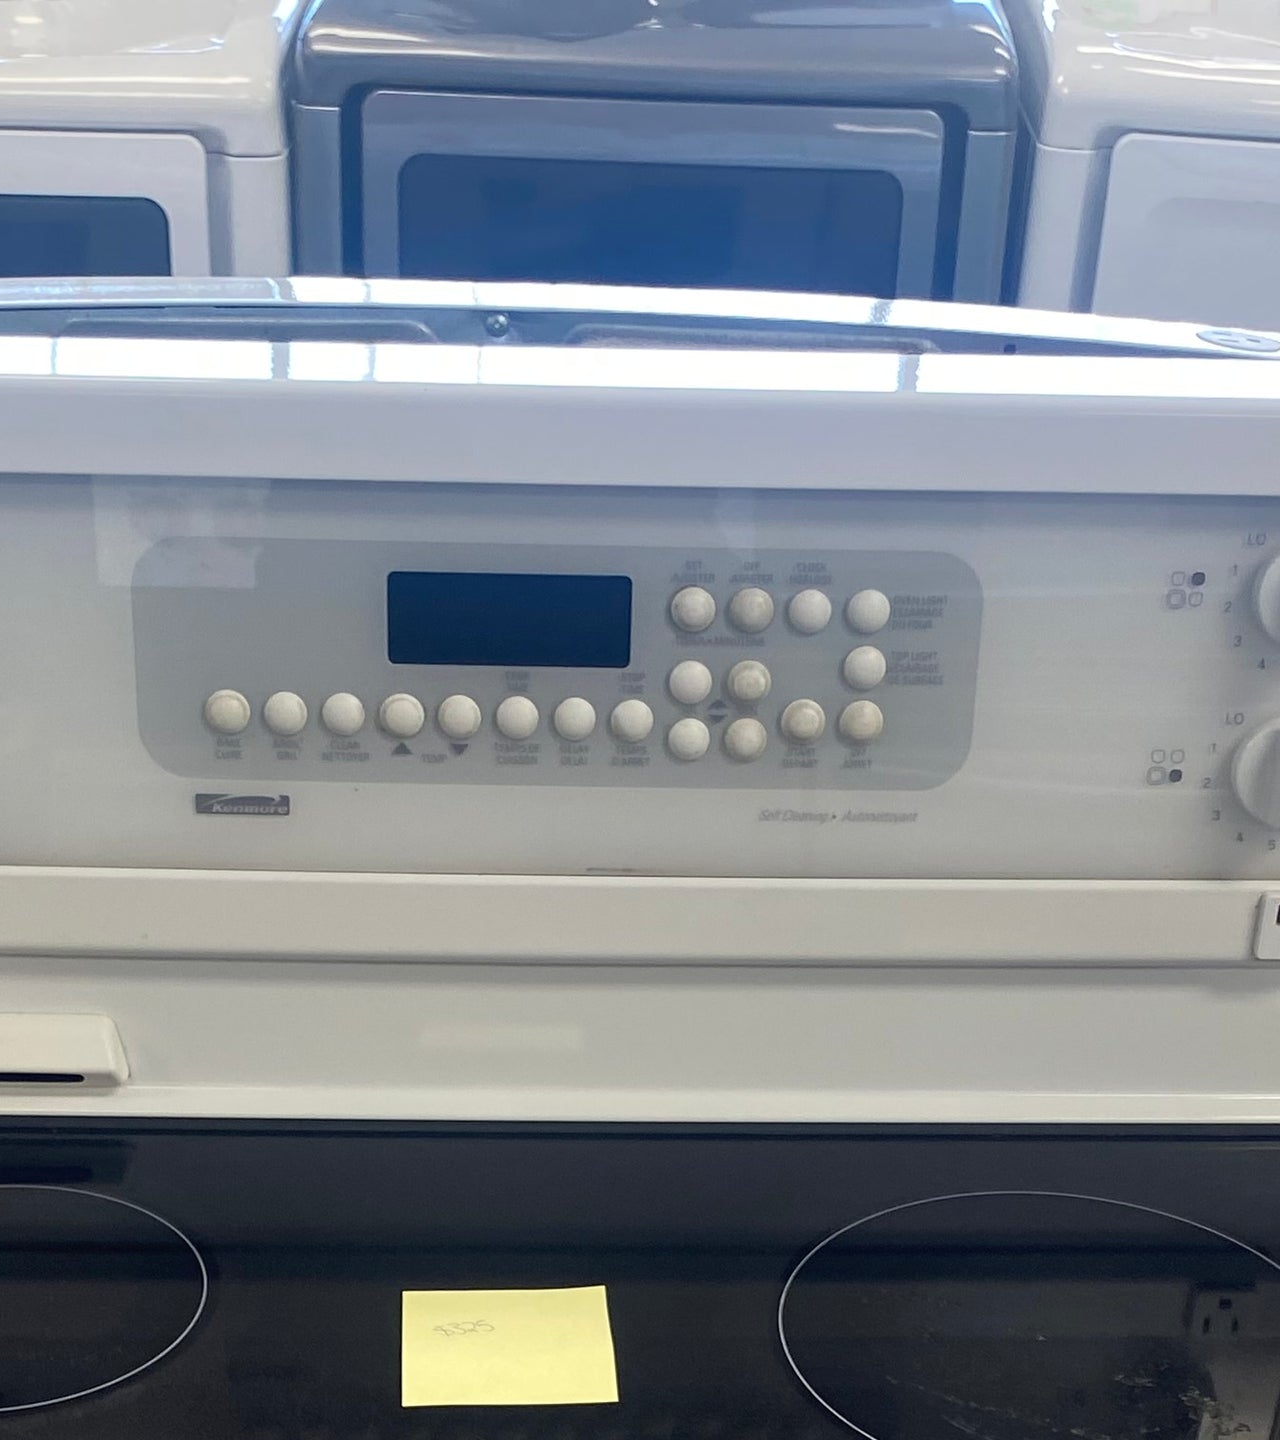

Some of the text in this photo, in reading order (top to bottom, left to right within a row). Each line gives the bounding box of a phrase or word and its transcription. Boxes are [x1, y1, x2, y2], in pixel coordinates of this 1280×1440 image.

[1246, 533, 1267, 546] LO
[1223, 600, 1233, 613] 2
[1233, 635, 1243, 648] 3
[1257, 658, 1266, 670] 4
[1225, 712, 1245, 726] LO
[1202, 777, 1212, 789] 2
[212, 802, 289, 815] Kenmore
[1211, 809, 1221, 822] 3
[1235, 832, 1244, 843] 4
[1267, 838, 1277, 851] 5
